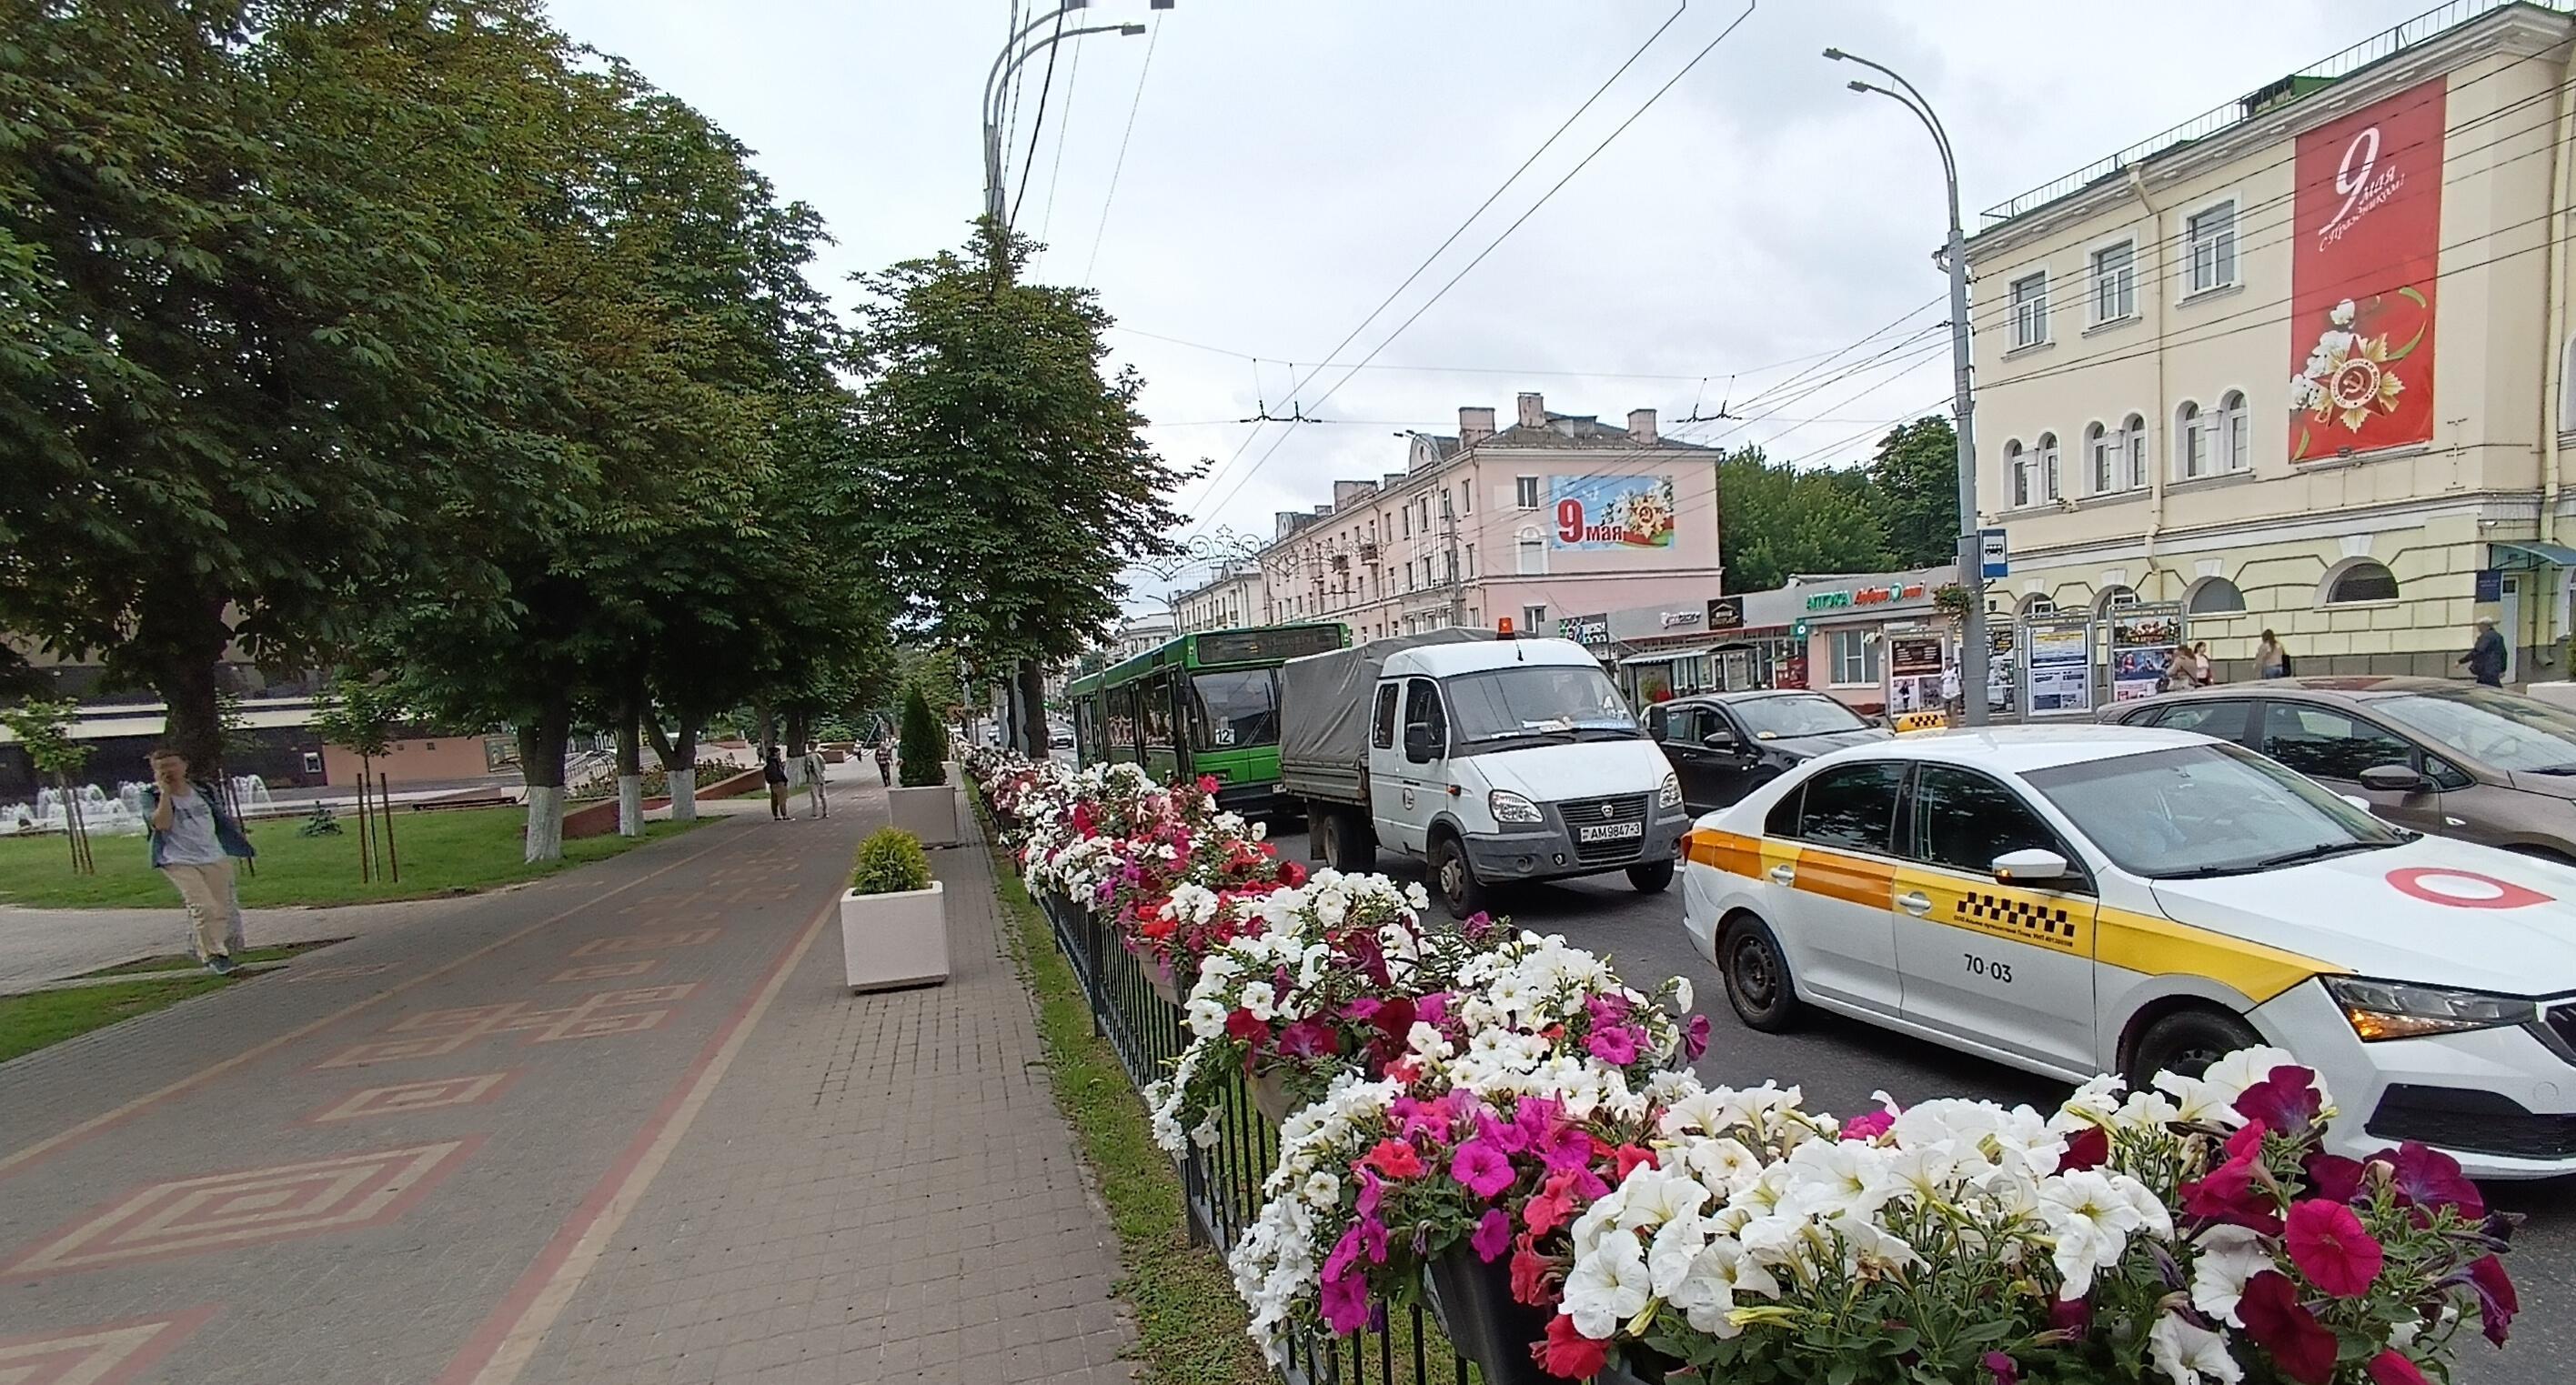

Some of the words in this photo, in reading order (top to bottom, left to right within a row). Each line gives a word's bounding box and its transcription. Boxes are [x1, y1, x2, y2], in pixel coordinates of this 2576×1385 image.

[2319, 127, 2380, 236] 9
[1558, 499, 1583, 543] 9
[1215, 729, 1231, 743] 12
